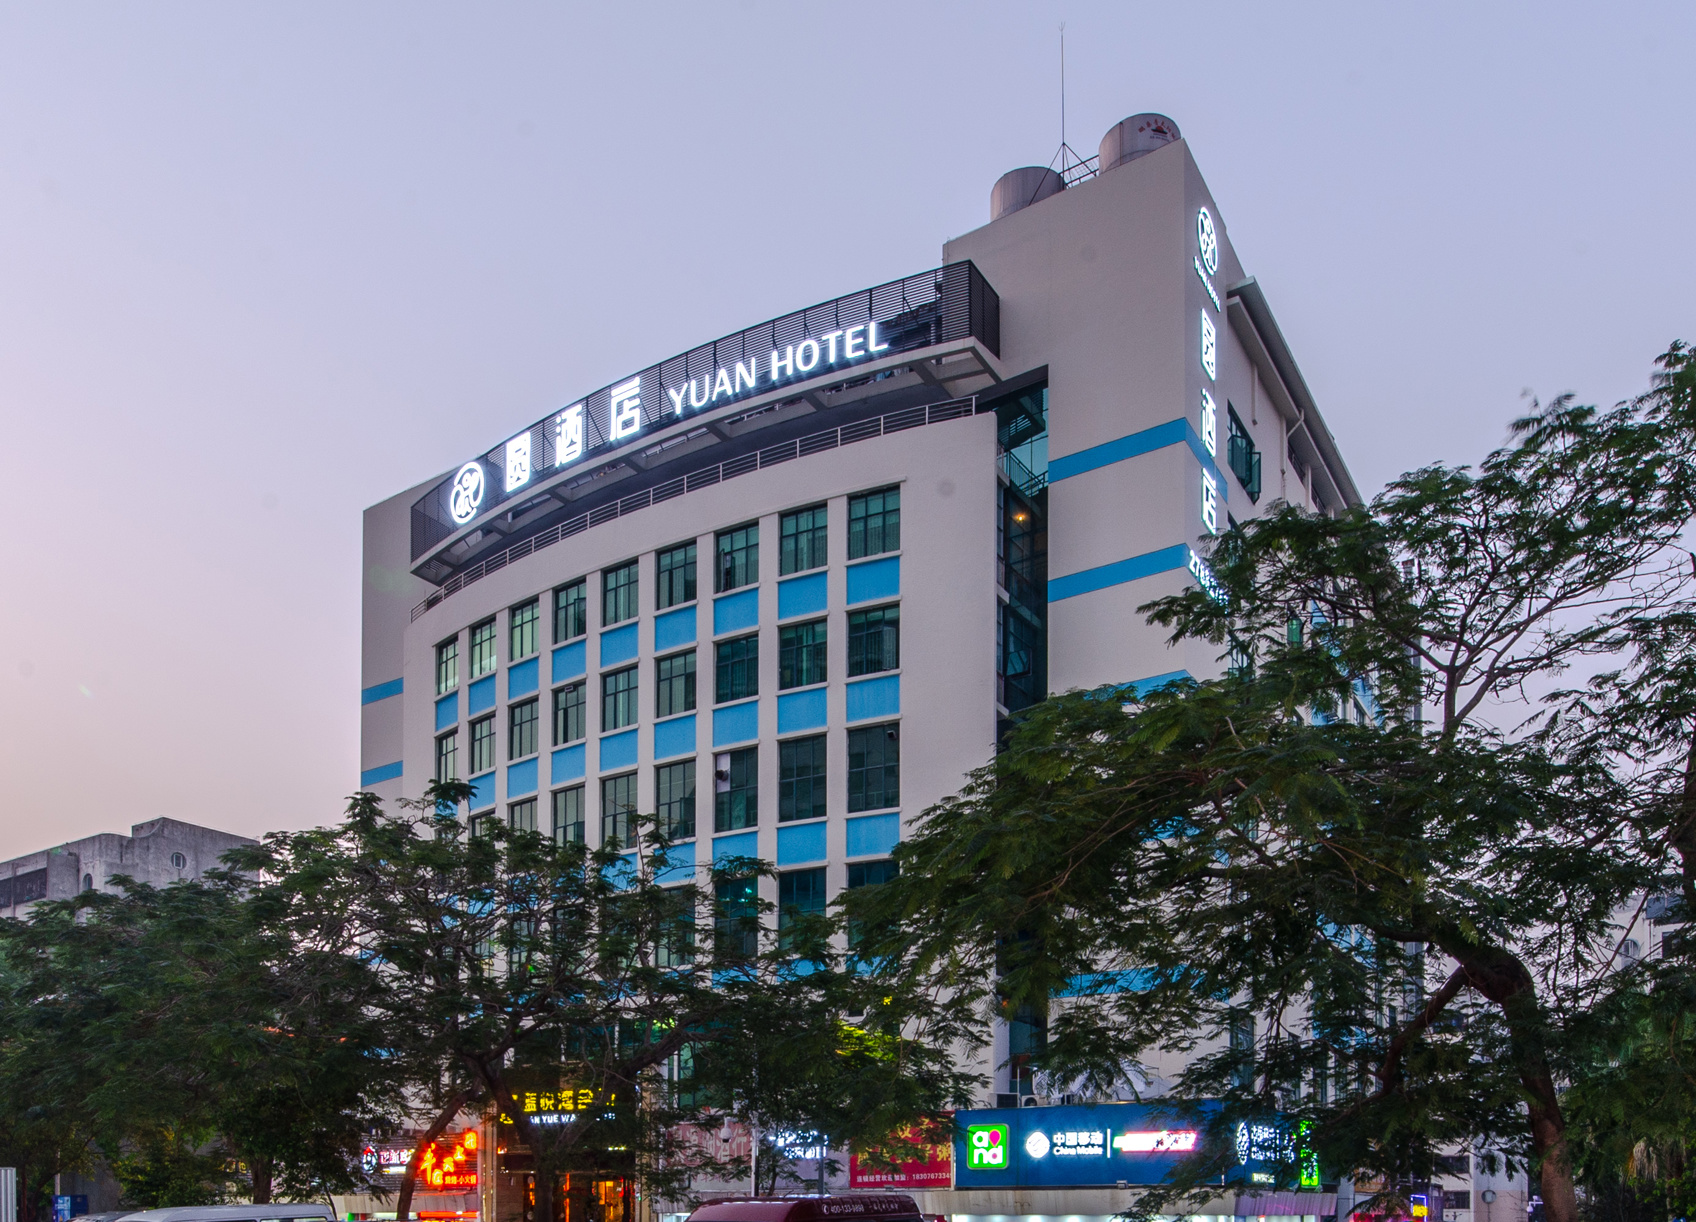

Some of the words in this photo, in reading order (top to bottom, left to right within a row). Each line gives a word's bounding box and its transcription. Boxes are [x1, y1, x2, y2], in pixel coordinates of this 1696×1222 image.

[668, 356, 757, 415] YUAN
[770, 321, 889, 382] HOTEL
[1053, 1131, 1104, 1146] 中国移动
[1053, 1147, 1077, 1155] China
[1077, 1146, 1103, 1155] Mobile
